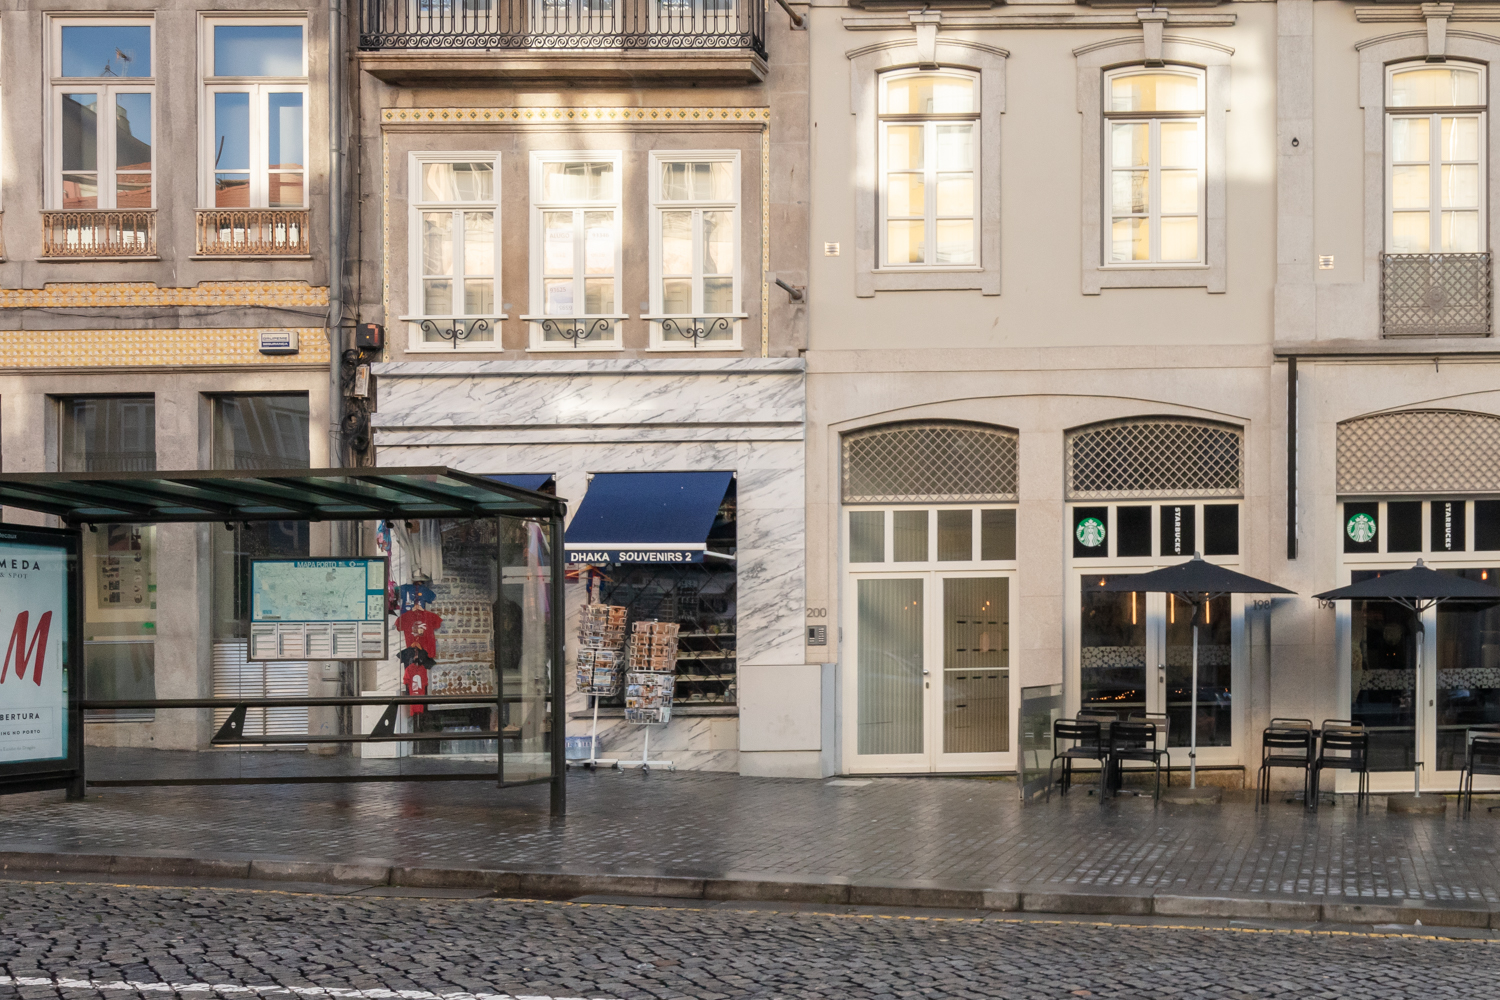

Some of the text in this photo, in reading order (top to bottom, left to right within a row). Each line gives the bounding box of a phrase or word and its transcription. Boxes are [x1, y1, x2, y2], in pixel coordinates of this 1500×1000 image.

[570, 552, 692, 562] DHAKA SOUVENIRS 2
[1253, 599, 1271, 610] 198
[1317, 599, 1335, 609] 196
[806, 607, 827, 618] 200
